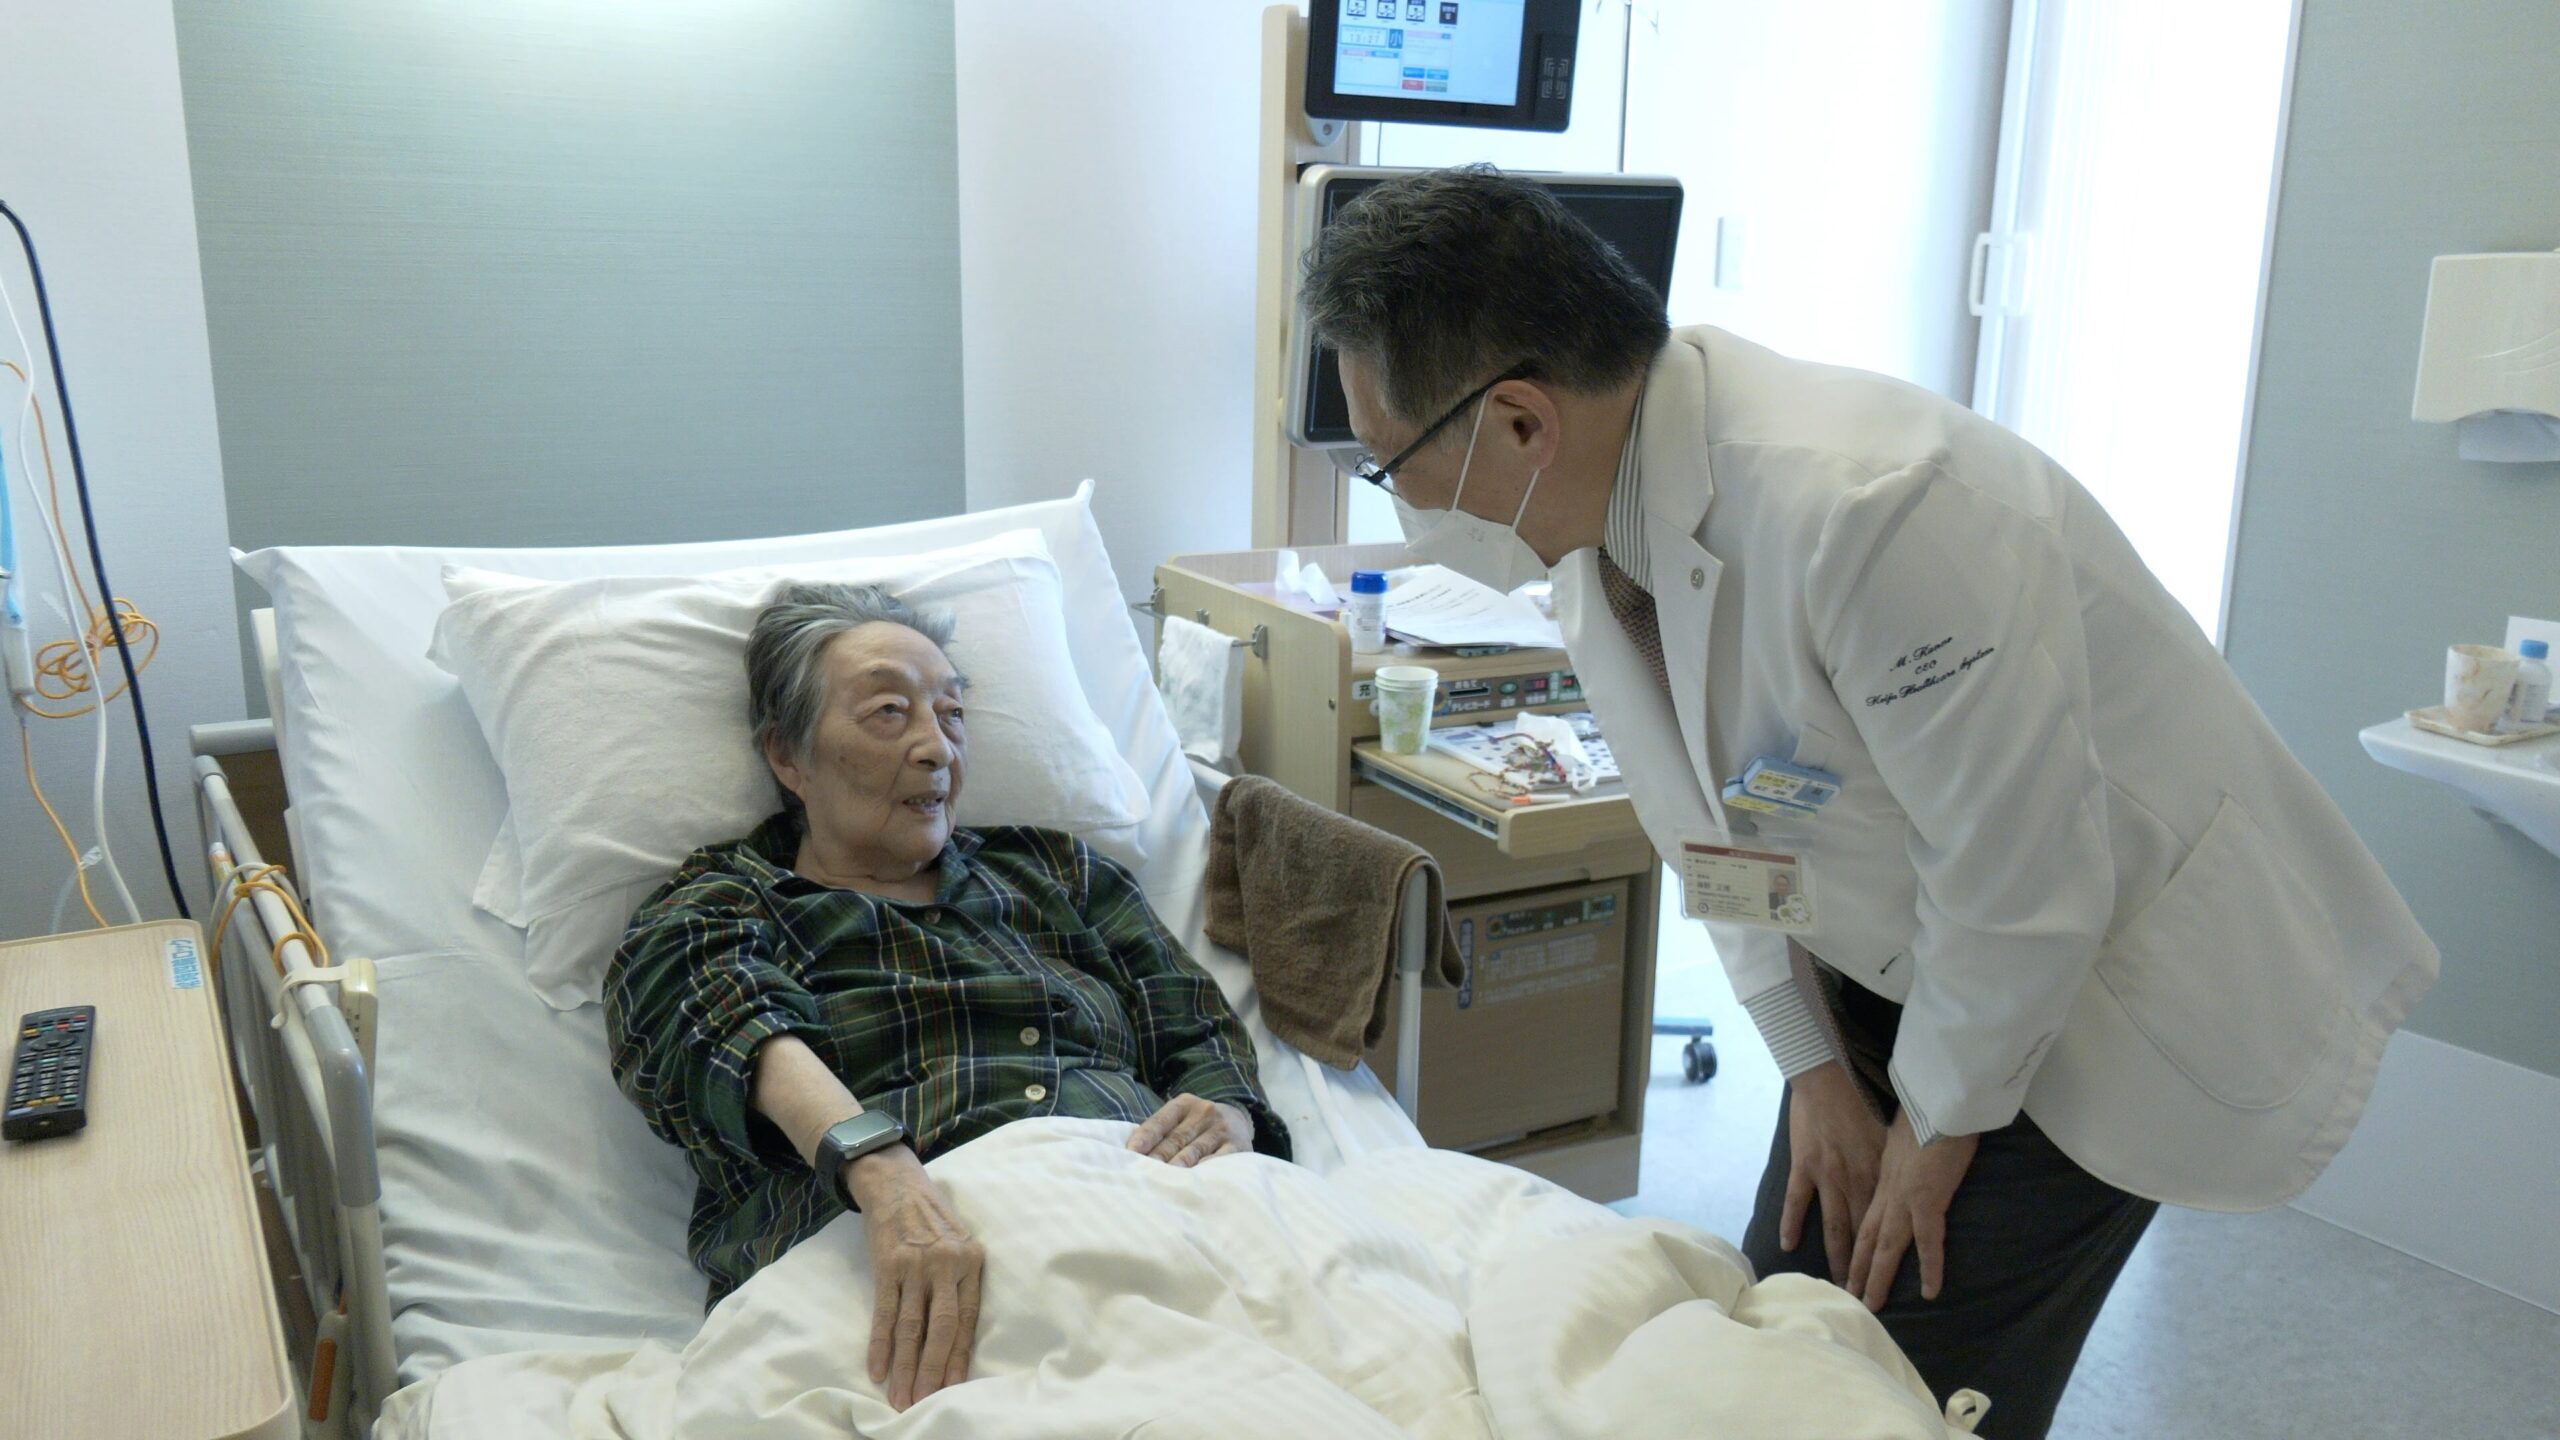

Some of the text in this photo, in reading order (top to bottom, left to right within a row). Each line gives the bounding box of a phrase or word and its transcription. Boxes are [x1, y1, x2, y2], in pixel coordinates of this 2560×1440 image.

[1889, 655, 1912, 672] M.
[1914, 659, 1937, 675] CEO
[1898, 669, 1957, 699] Healthcare
[1959, 646, 1995, 672] System
